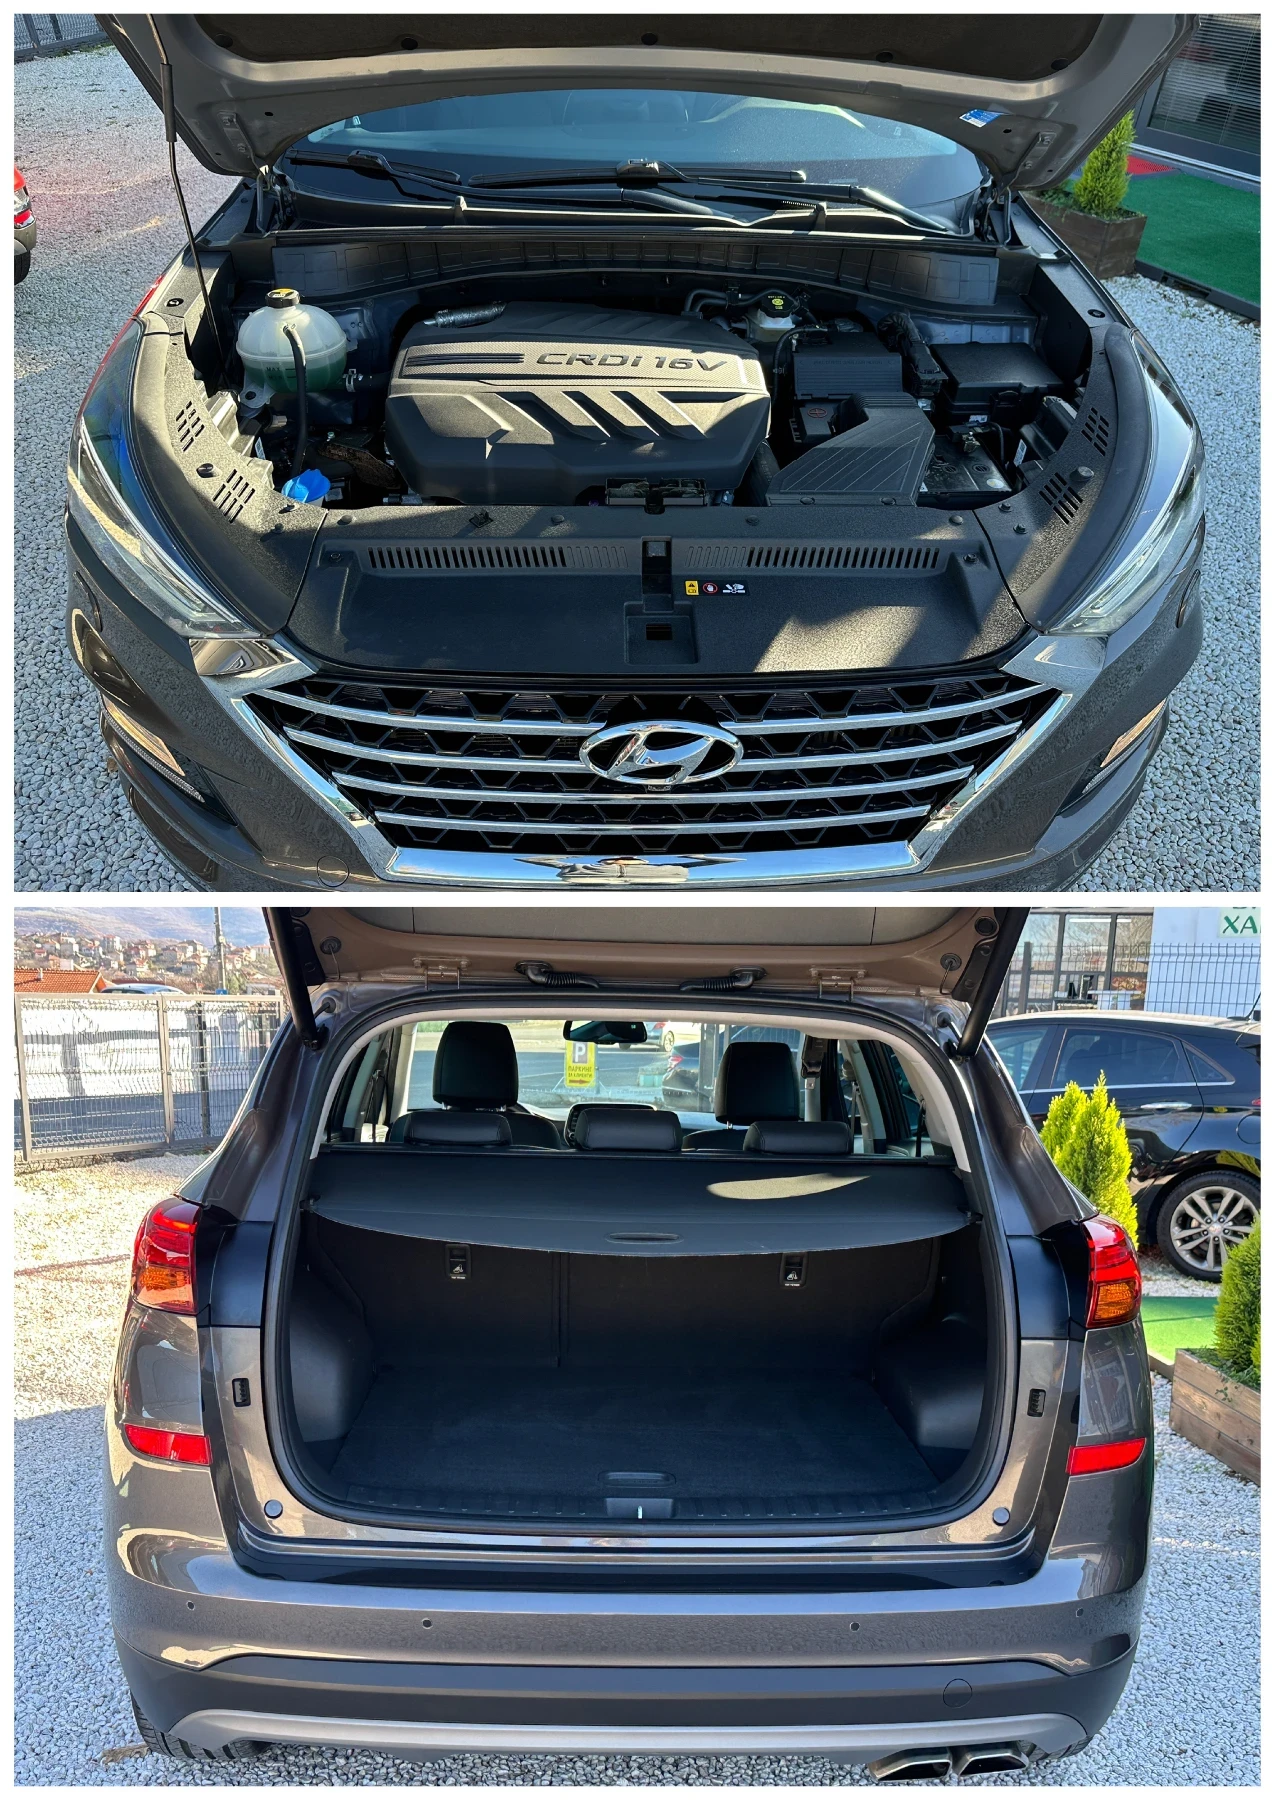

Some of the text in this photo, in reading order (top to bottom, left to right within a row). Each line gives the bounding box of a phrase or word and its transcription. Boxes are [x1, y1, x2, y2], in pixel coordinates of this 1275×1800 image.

[654, 355, 728, 372] 16V
[1222, 914, 1261, 934] ХА
[574, 1042, 586, 1063] P
